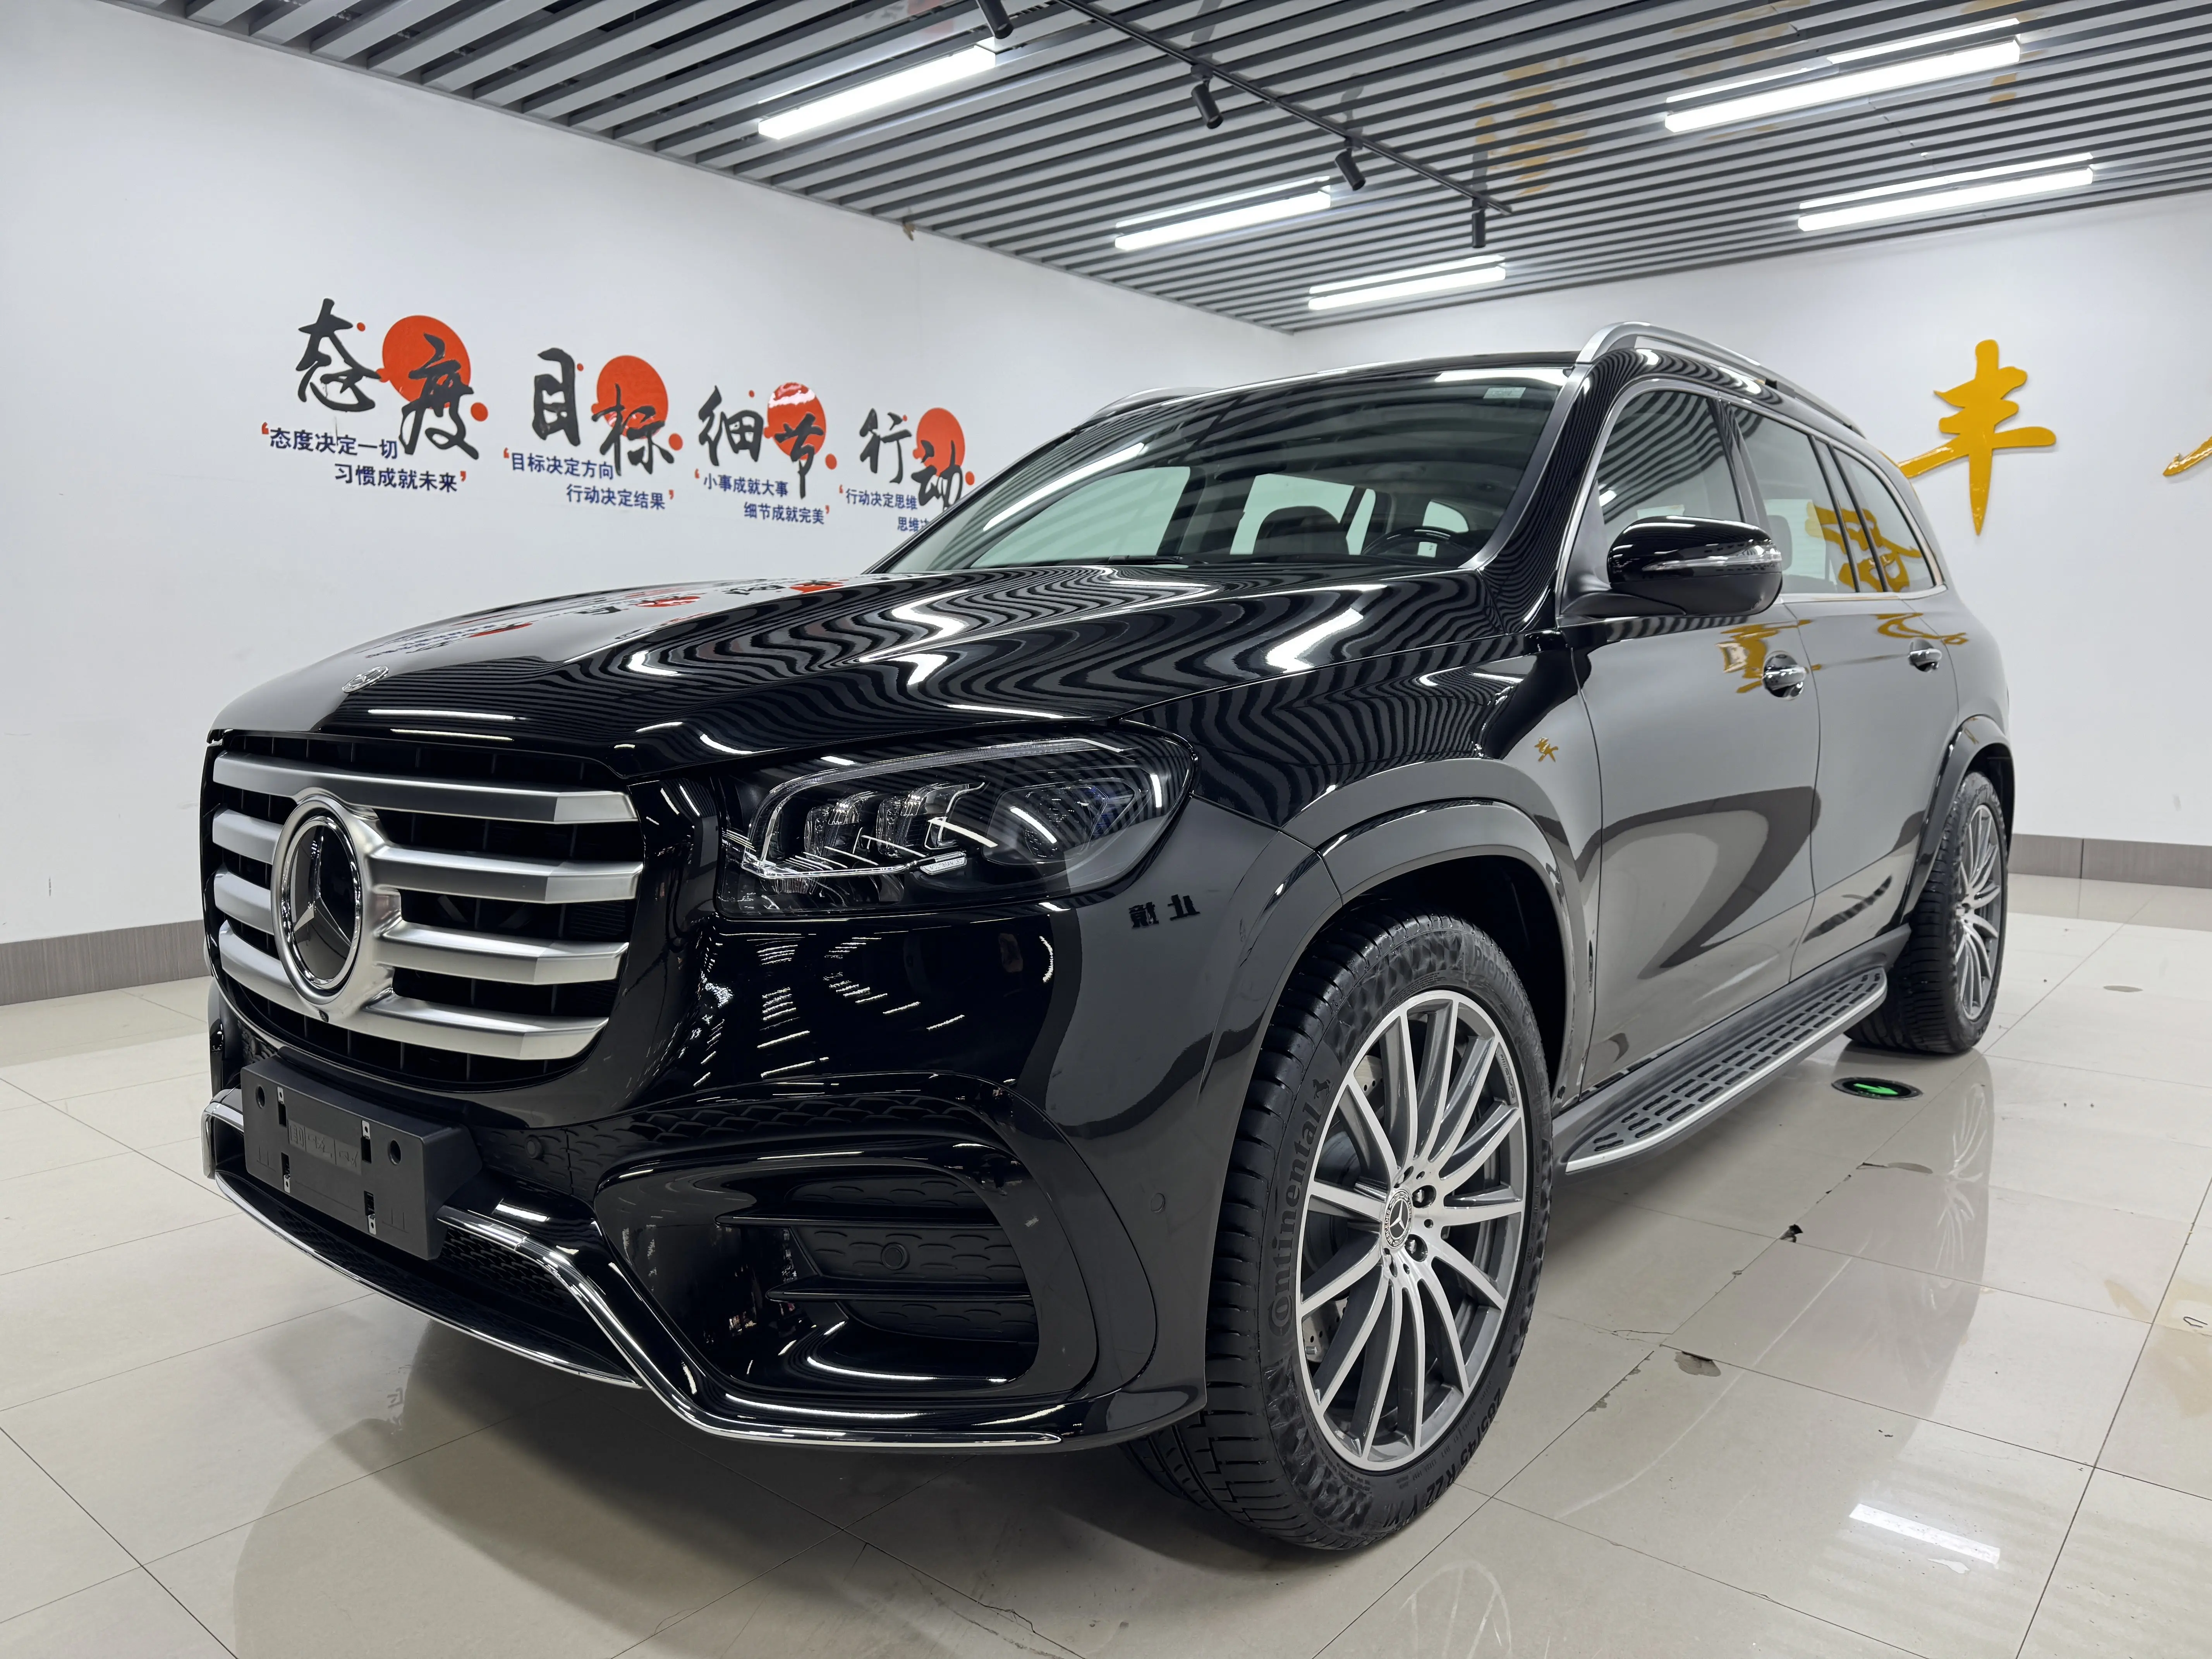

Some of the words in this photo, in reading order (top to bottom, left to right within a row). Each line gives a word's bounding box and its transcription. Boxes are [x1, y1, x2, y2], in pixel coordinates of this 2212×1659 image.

[295, 298, 479, 460] 态度
[532, 347, 674, 476] 目标
[698, 385, 824, 500] 细节
[859, 408, 963, 511] 行动
[1268, 1102, 1322, 1337] Continental
